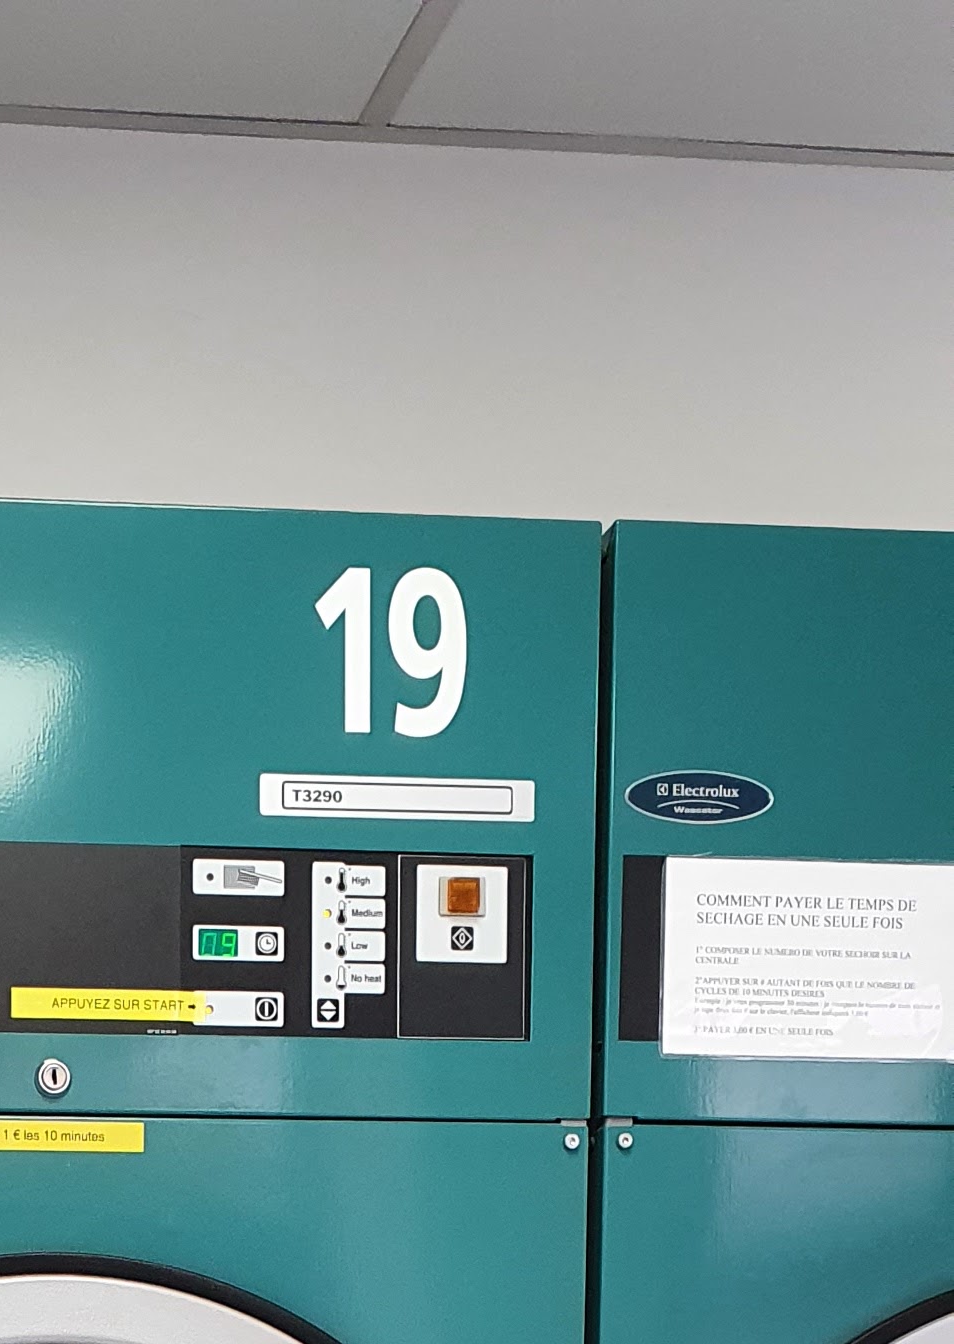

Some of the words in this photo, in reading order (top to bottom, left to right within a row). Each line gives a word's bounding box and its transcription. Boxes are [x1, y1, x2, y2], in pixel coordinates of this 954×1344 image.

[314, 567, 467, 738] 19
[292, 789, 343, 804] T3290
[672, 783, 740, 798] Electrolux
[351, 876, 371, 887] High
[696, 893, 772, 908] COMMENT
[775, 895, 822, 910] PAYER
[826, 897, 844, 910] LE
[847, 897, 894, 912] TEMPS
[897, 899, 917, 912] DE
[351, 908, 384, 918] Medium
[696, 911, 764, 926] SECHAGE
[767, 913, 787, 926] EN
[790, 914, 820, 928] UNE
[823, 915, 869, 929] SEULE
[872, 916, 903, 930] FOIS
[350, 941, 369, 950] Low
[350, 973, 363, 983] No
[364, 973, 382, 983] heat
[51, 997, 111, 1010] APPUYEZ
[113, 998, 140, 1011] SUR
[143, 998, 185, 1012] START
[3, 1128, 8, 1141] 1
[12, 1128, 21, 1141] €
[23, 1129, 40, 1141] les
[44, 1129, 58, 1142] 10
[60, 1130, 105, 1143] minutes
